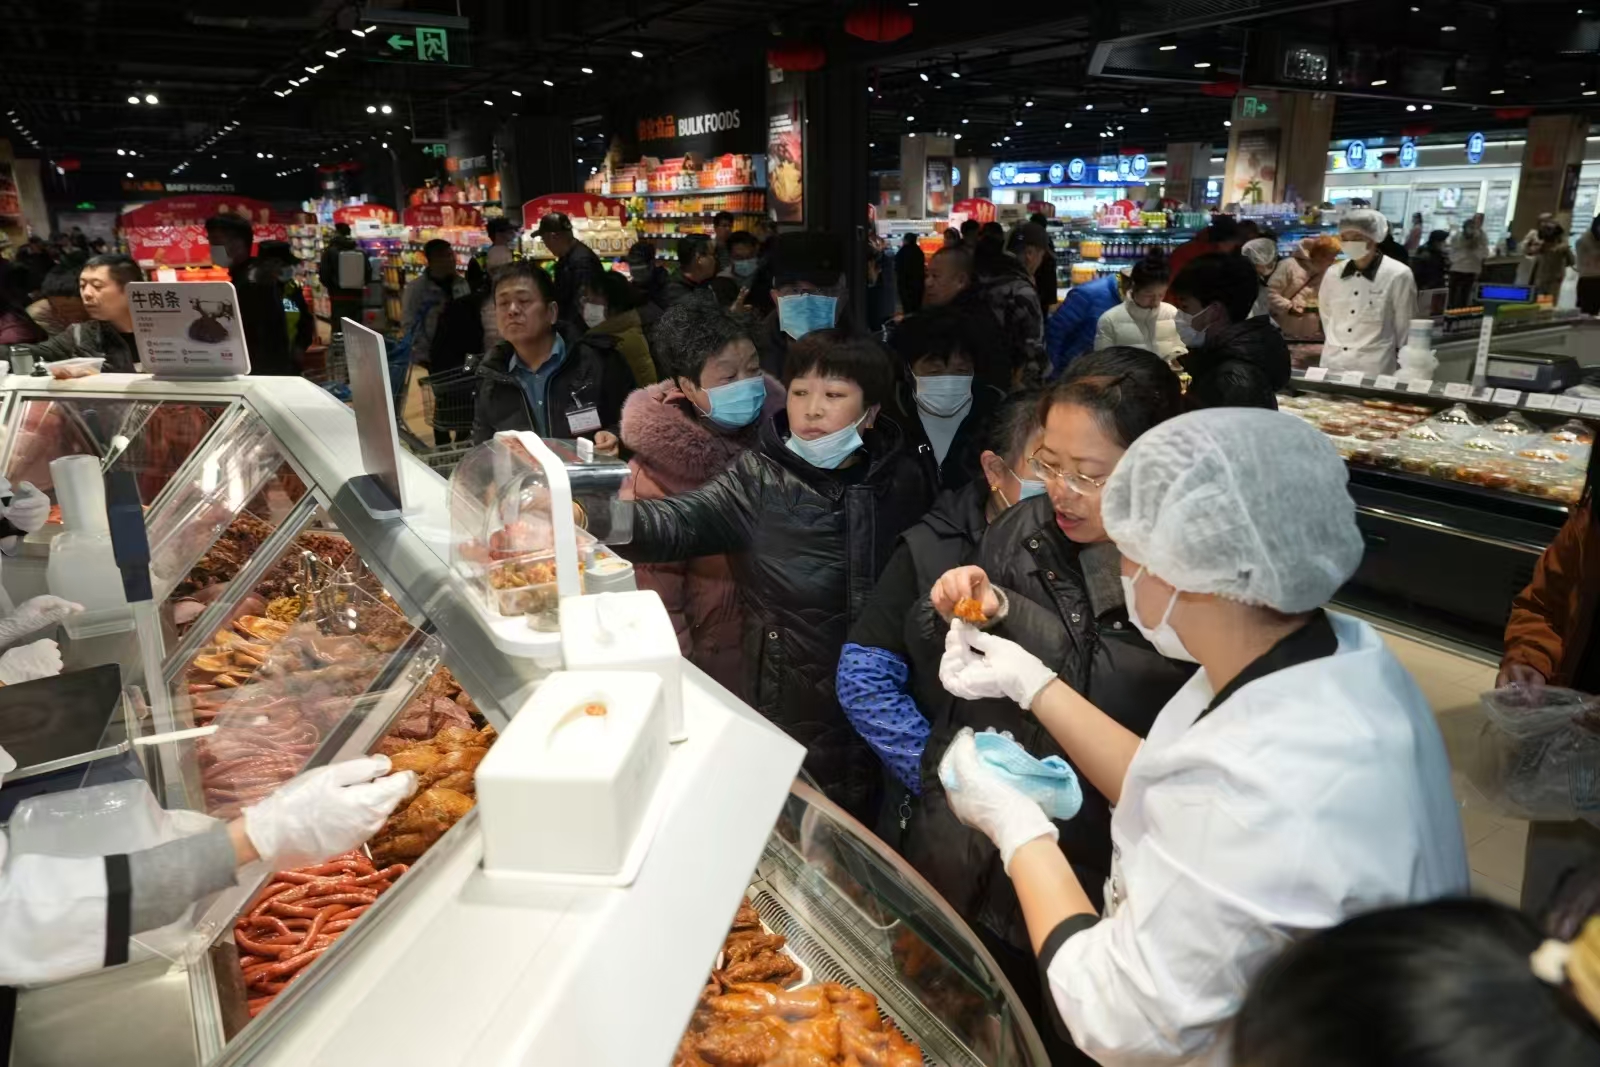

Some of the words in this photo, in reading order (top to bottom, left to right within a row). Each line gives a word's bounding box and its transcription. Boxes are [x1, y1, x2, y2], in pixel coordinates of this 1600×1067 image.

[678, 115, 704, 136] BULK
[704, 109, 740, 133] FOODS
[132, 290, 180, 308] 牛肉条
